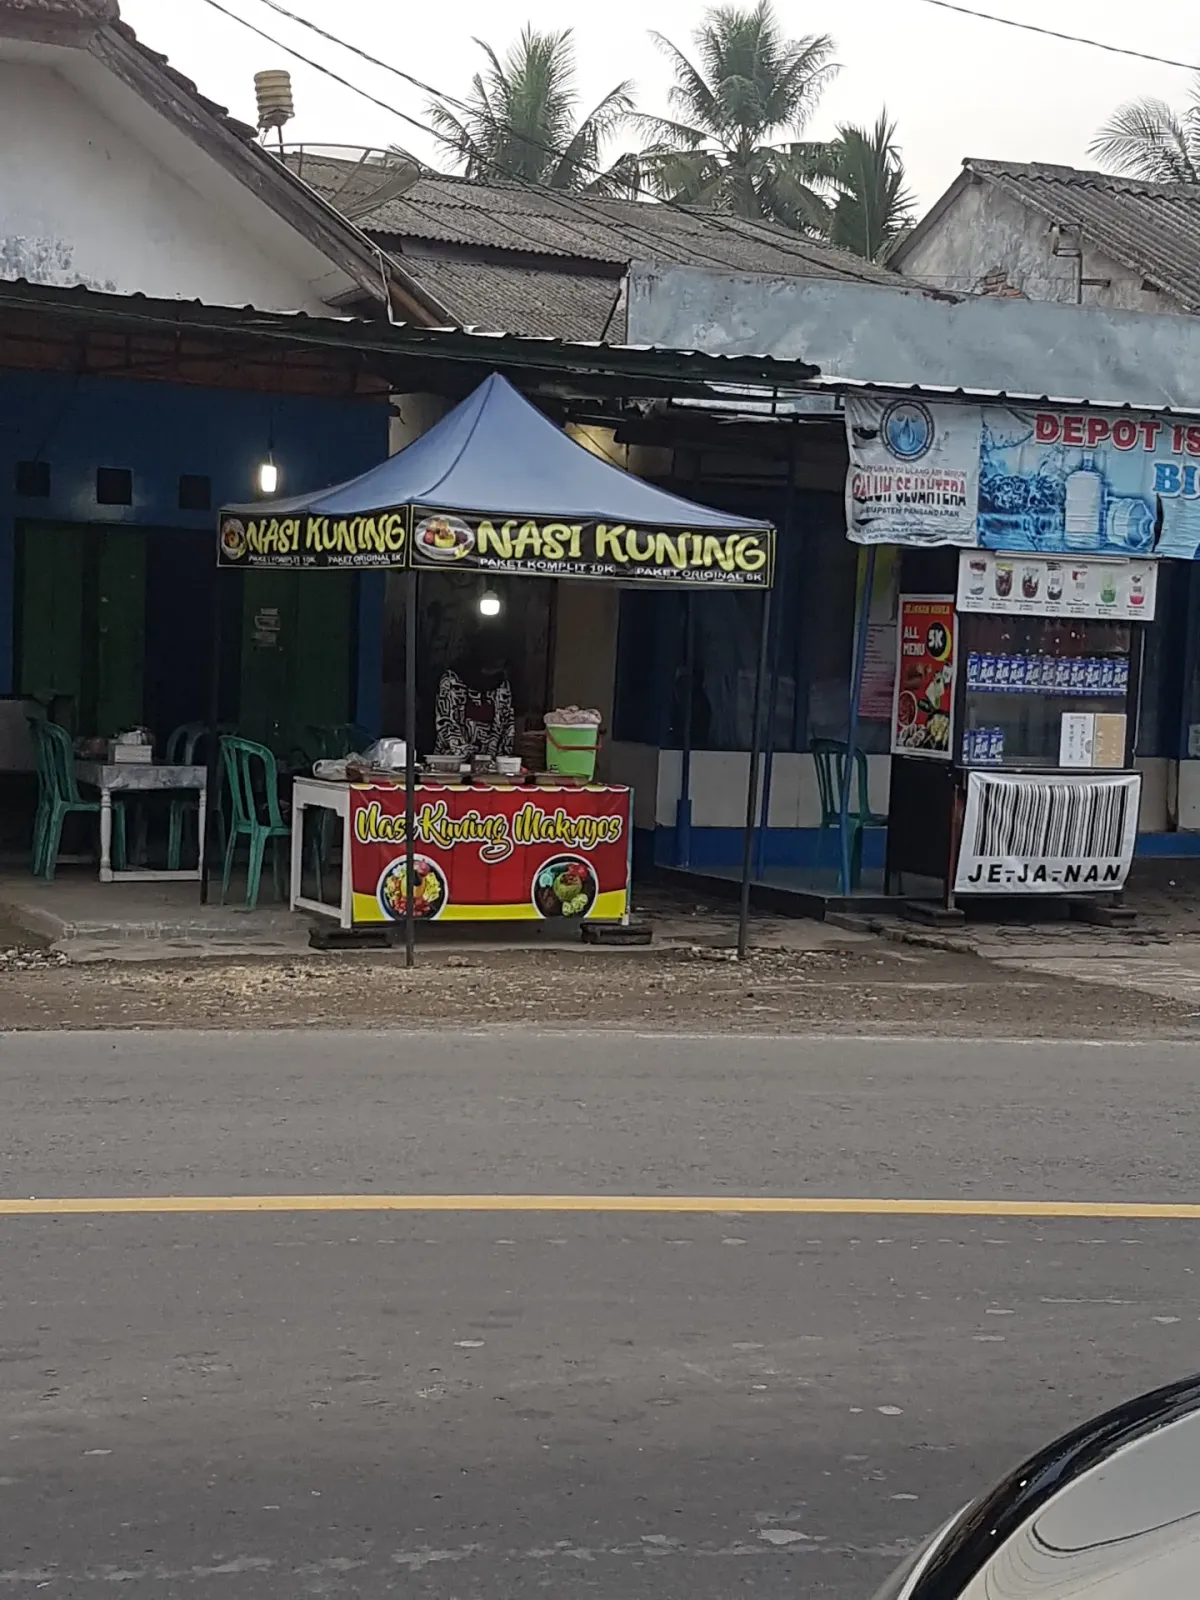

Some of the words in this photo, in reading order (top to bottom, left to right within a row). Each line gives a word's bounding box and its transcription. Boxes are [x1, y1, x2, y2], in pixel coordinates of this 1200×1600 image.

[1034, 412, 1163, 452] DEPOT
[246, 518, 300, 554] NASI
[306, 514, 405, 553] KUNING
[477, 520, 582, 559] NASI
[596, 525, 766, 571] KUNING
[480, 558, 522, 568] PAKET
[527, 561, 587, 572] KOMPLIT
[590, 564, 614, 573] 10K
[636, 568, 678, 577] PAKET
[682, 570, 743, 580] ORIGINAL
[903, 626, 920, 639] ALL
[356, 802, 418, 842] Nas
[417, 801, 513, 863] Kuning
[514, 802, 623, 850] Maknyos
